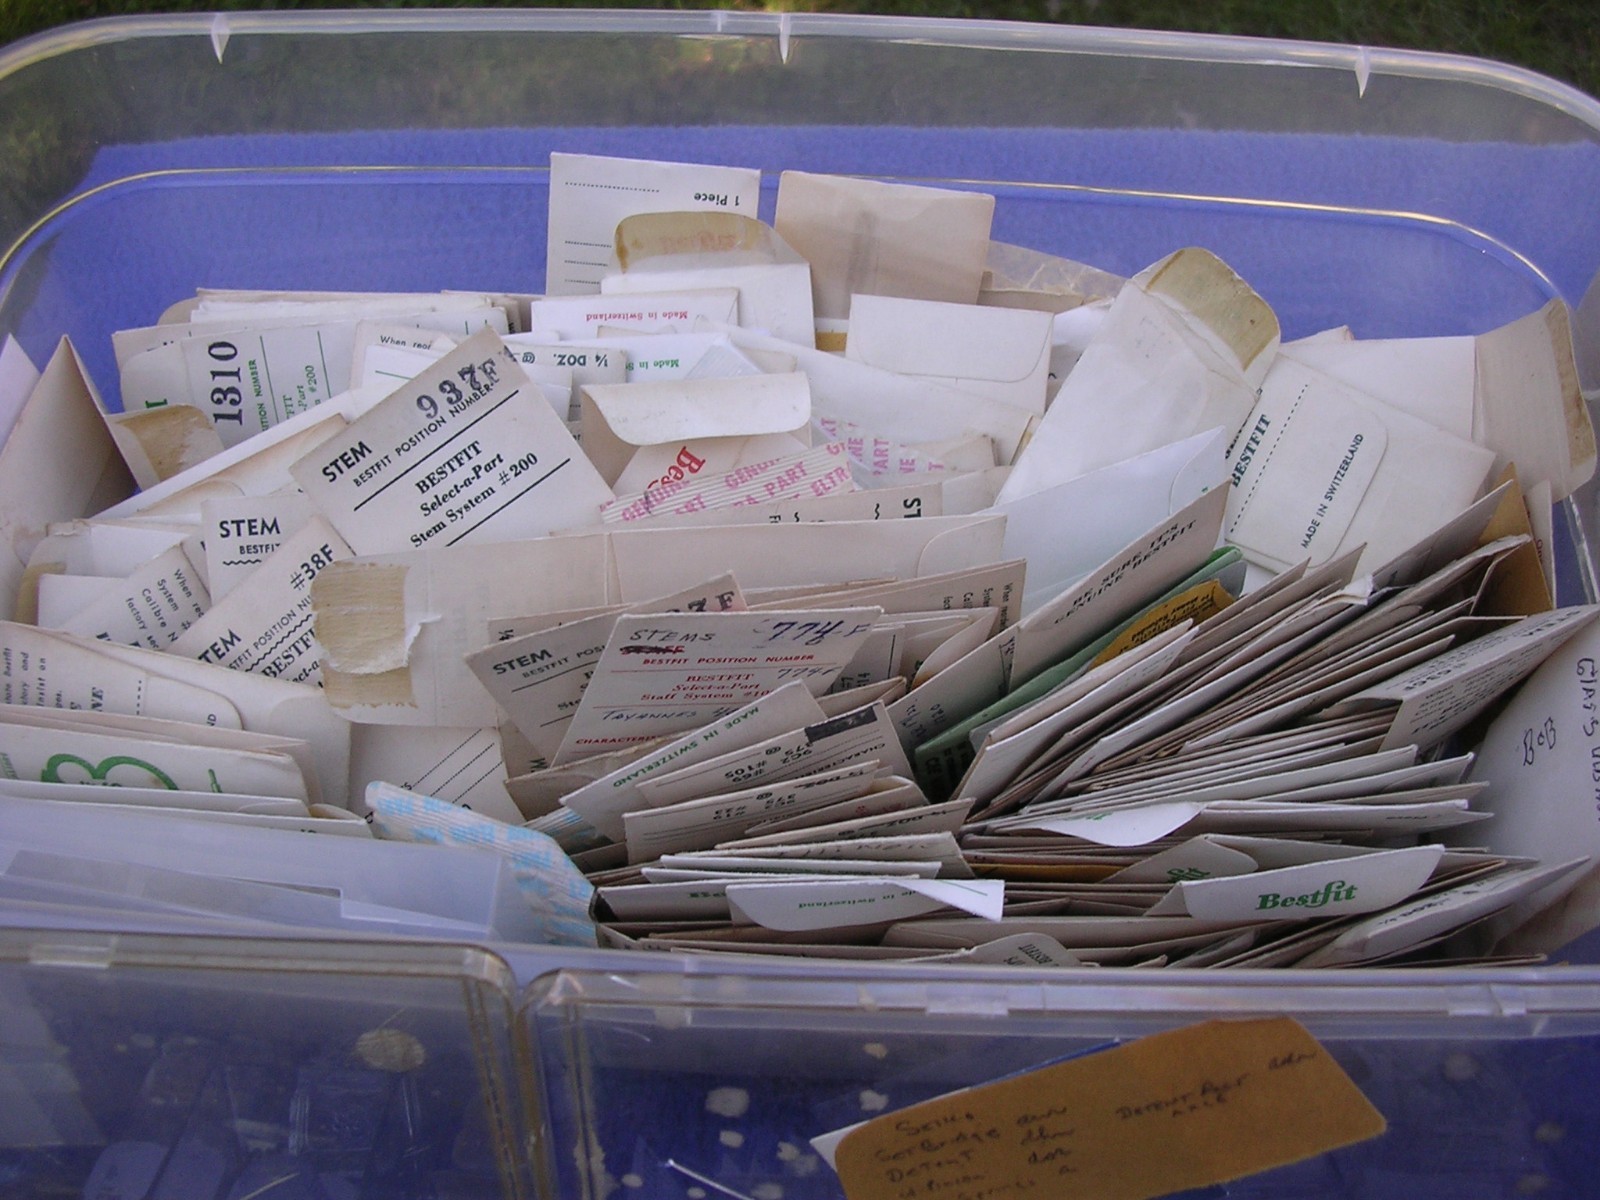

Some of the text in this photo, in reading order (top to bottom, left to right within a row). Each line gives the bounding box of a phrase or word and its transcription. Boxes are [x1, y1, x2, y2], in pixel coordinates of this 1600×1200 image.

[694, 192, 728, 206] Piece
[586, 310, 688, 322] Made in Switzerland
[379, 334, 405, 346] When
[248, 359, 263, 397] NUMBER
[639, 360, 649, 369] in
[653, 359, 680, 368] Made
[207, 341, 243, 426] 1310
[322, 441, 372, 483] STEM
[353, 456, 393, 488] BESTFIT
[395, 419, 447, 457] POSITION
[1231, 414, 1271, 488] BESTFIT
[414, 440, 483, 495] BESTFIT
[410, 452, 539, 548] Stem System #200
[420, 453, 504, 517] Select-a-Part
[1300, 433, 1365, 549] MADE IN SWITZERLAND
[219, 517, 281, 539] STEM
[1132, 519, 1197, 569] BESTFIT
[239, 543, 281, 555] BESTFI
[174, 568, 193, 599] When
[290, 544, 335, 591] #38F
[1101, 552, 1142, 585] SURE
[142, 588, 167, 629] Calibre
[157, 578, 180, 612] System
[126, 597, 149, 632] factory
[253, 609, 297, 650] POSITION
[630, 628, 716, 643] STEMS
[493, 648, 553, 675] STEM
[522, 657, 570, 679] BESTFIT
[642, 654, 815, 665] BESTFIT POSITION NUMBER
[686, 673, 754, 682] BESTFIT
[640, 692, 675, 701] Staff
[684, 692, 733, 701] System
[729, 706, 760, 728] MADE
[703, 730, 720, 742] IN
[612, 740, 698, 788] SWITZERLAND
[724, 759, 768, 779] #105
[1255, 879, 1360, 911] Bestfit
